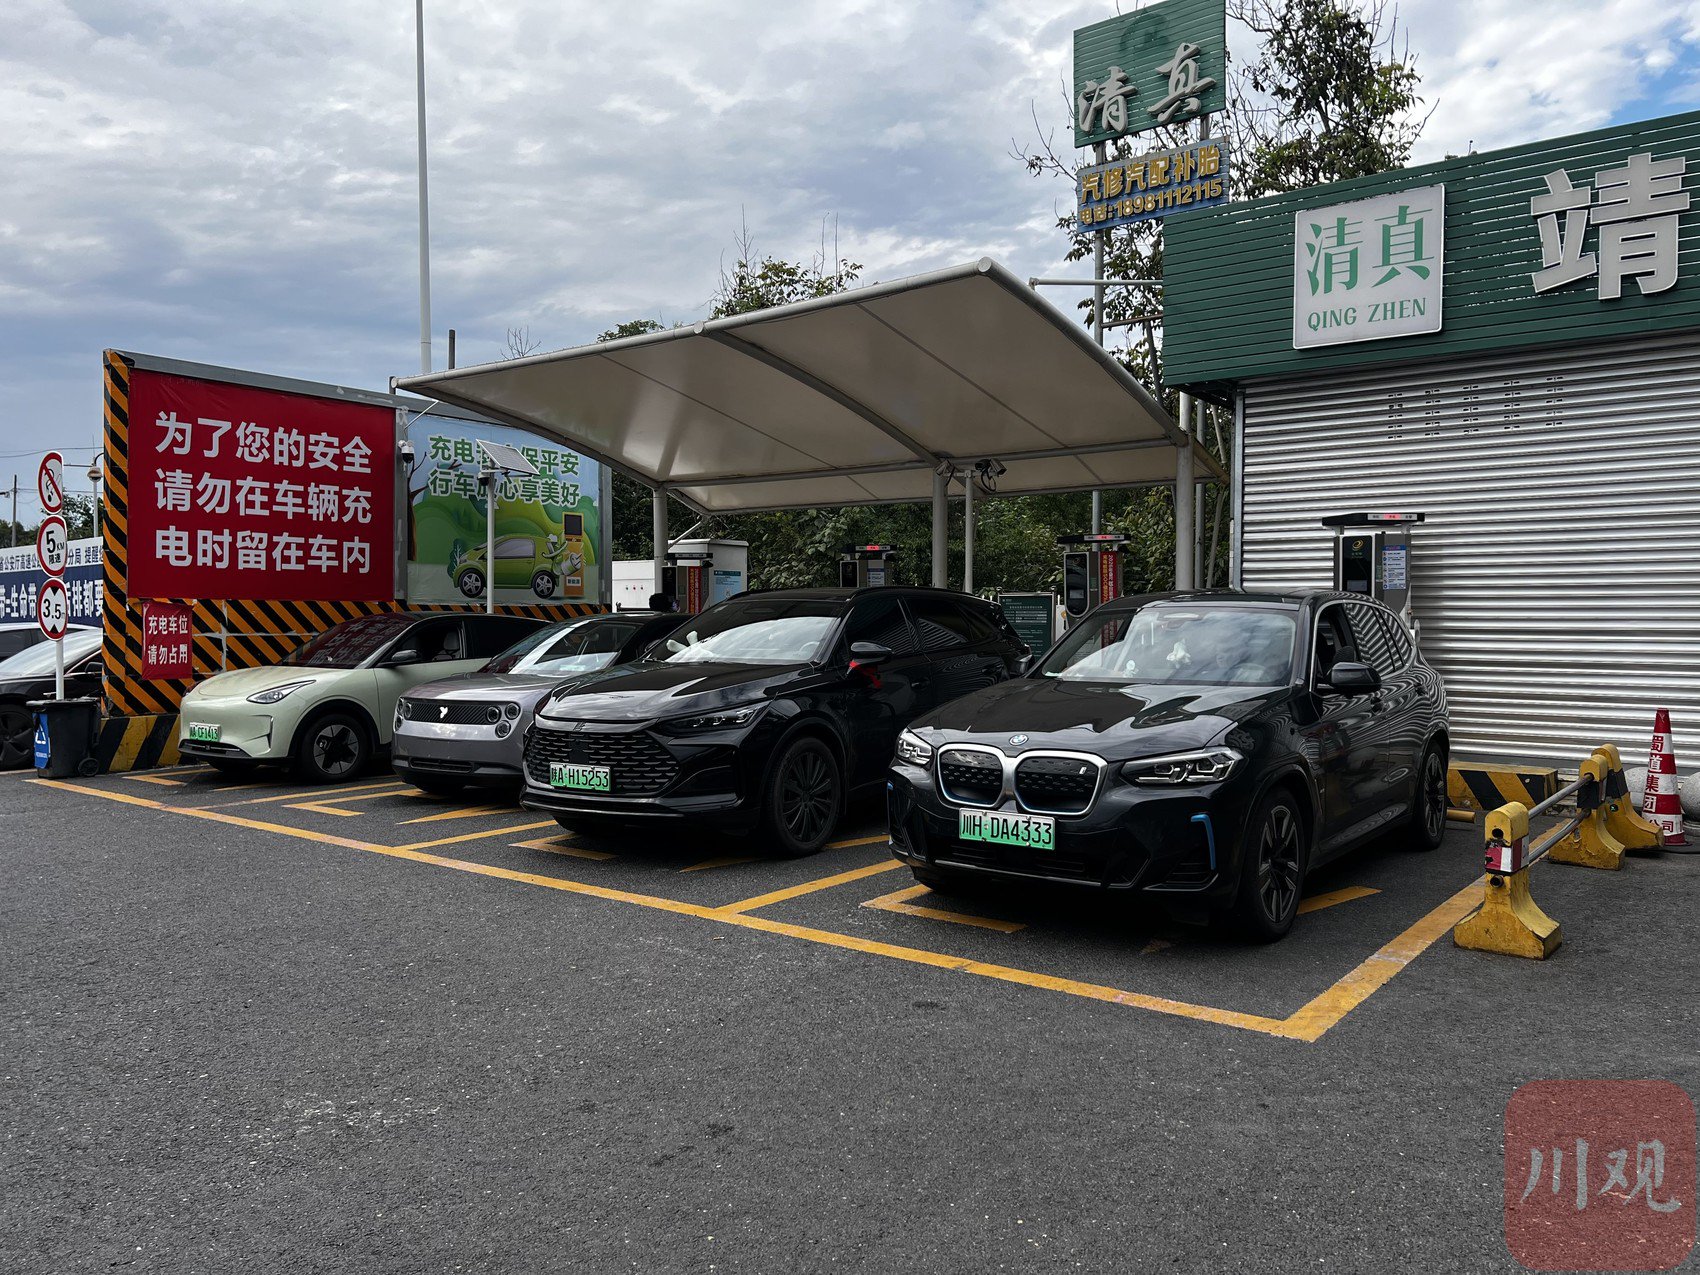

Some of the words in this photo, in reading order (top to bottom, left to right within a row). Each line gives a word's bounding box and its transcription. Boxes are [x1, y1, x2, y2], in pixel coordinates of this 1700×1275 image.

[1078, 42, 1217, 133] 清真
[1081, 145, 1220, 203] 汽修汽配补胎
[1305, 205, 1435, 297] 清真
[1530, 152, 1690, 300] 靖
[1307, 307, 1357, 331] QING
[1367, 297, 1426, 323] ZHEN
[155, 411, 372, 473] 为了您的安全
[429, 436, 579, 476] 充电保平安
[155, 468, 372, 524] 请勿在车辆充
[155, 525, 371, 574] 电时留在车内
[148, 614, 189, 635] 充电车位
[147, 644, 188, 665] 请勿占用
[1644, 735, 1664, 813] 蜀道集团
